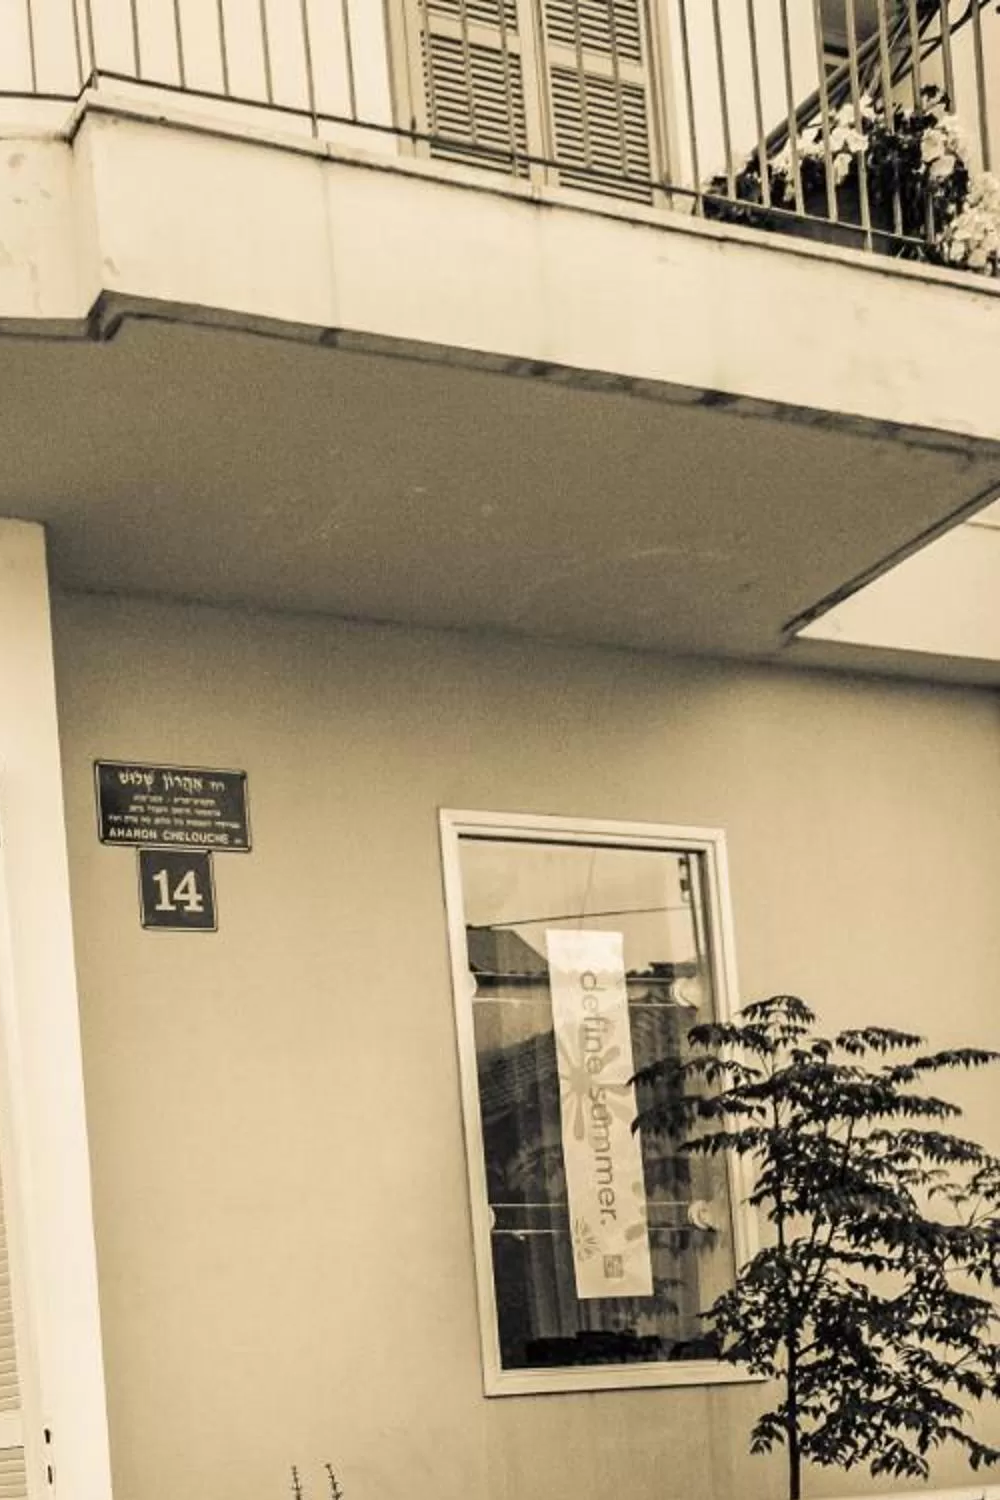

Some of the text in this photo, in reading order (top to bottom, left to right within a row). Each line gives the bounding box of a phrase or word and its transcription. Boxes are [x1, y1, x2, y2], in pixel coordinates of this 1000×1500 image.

[108, 827, 157, 840] AHARON
[162, 830, 229, 844] CHELOUCHE
[152, 869, 204, 912] 14
[579, 970, 609, 1074] define
